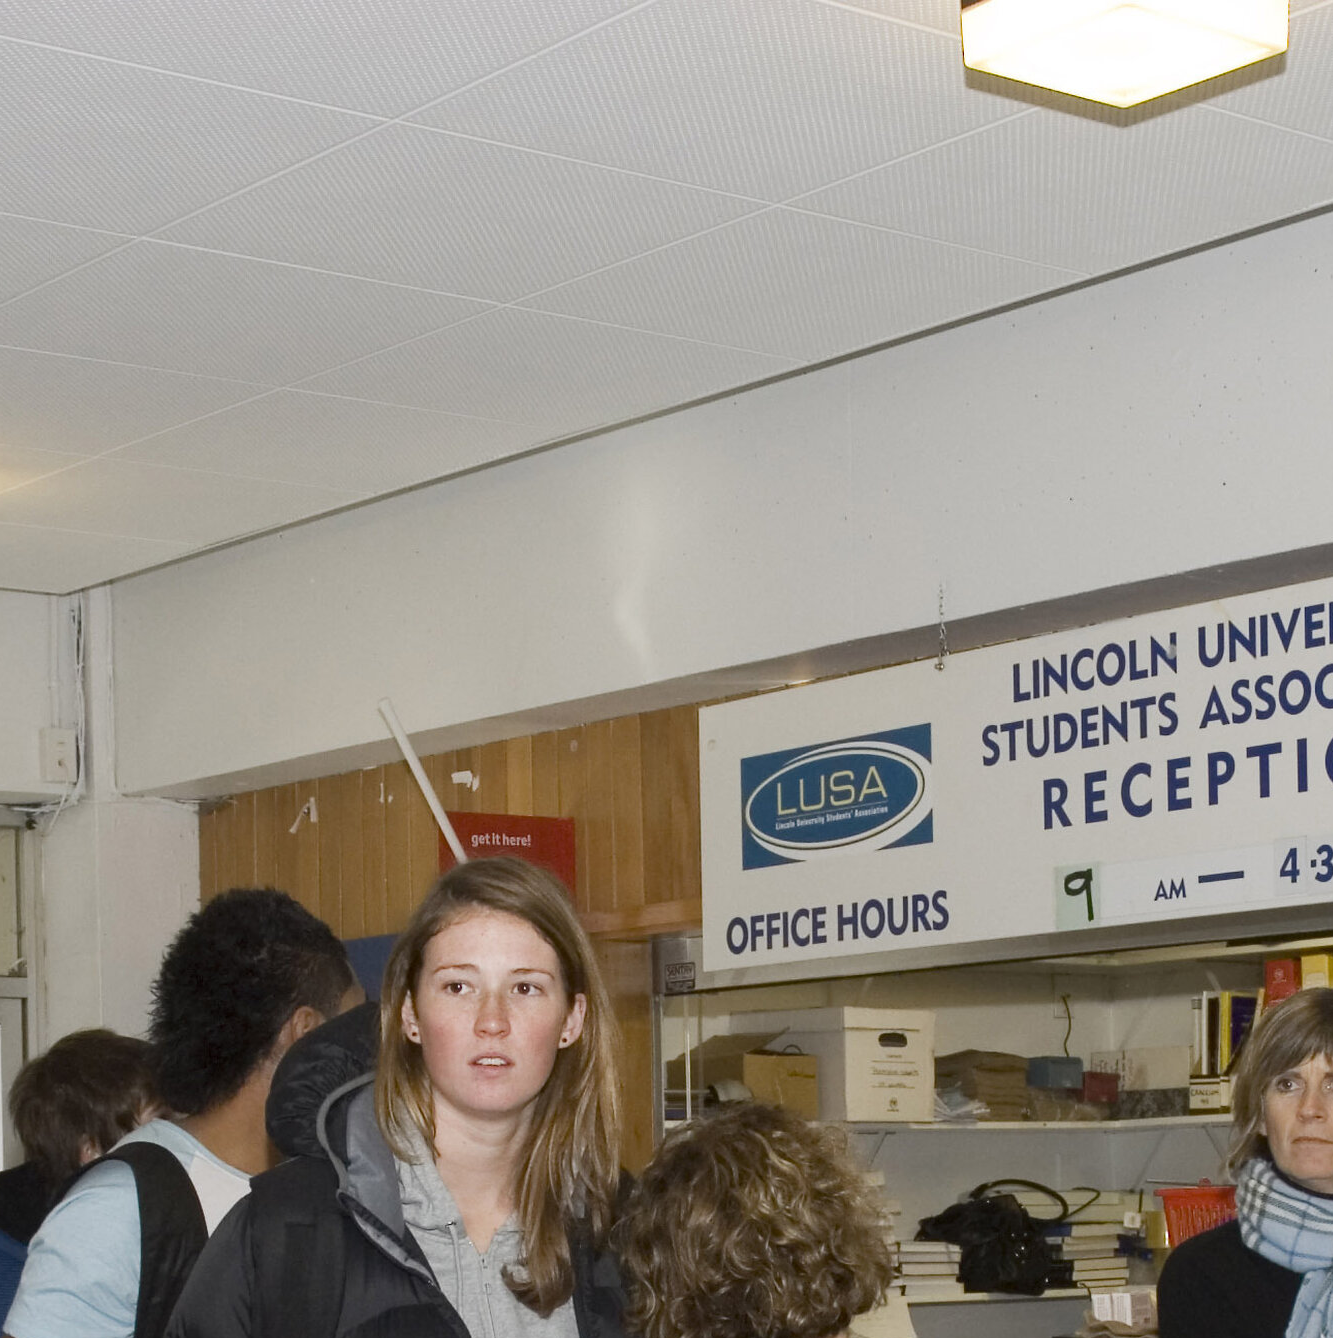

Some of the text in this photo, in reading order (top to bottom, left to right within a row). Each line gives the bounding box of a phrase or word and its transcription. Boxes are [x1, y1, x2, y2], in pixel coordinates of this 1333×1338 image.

[1012, 633, 1178, 703] LINCOLN
[982, 692, 1179, 767] STUDENTS
[777, 766, 888, 815] LUSA
[471, 832, 531, 847] get it here!
[775, 820, 795, 830] Lincoln
[796, 816, 825, 827] University
[854, 806, 889, 817] Association
[1064, 868, 1094, 921] 9
[1154, 879, 1187, 902] AM
[726, 890, 949, 955] OFFICE HOURS
